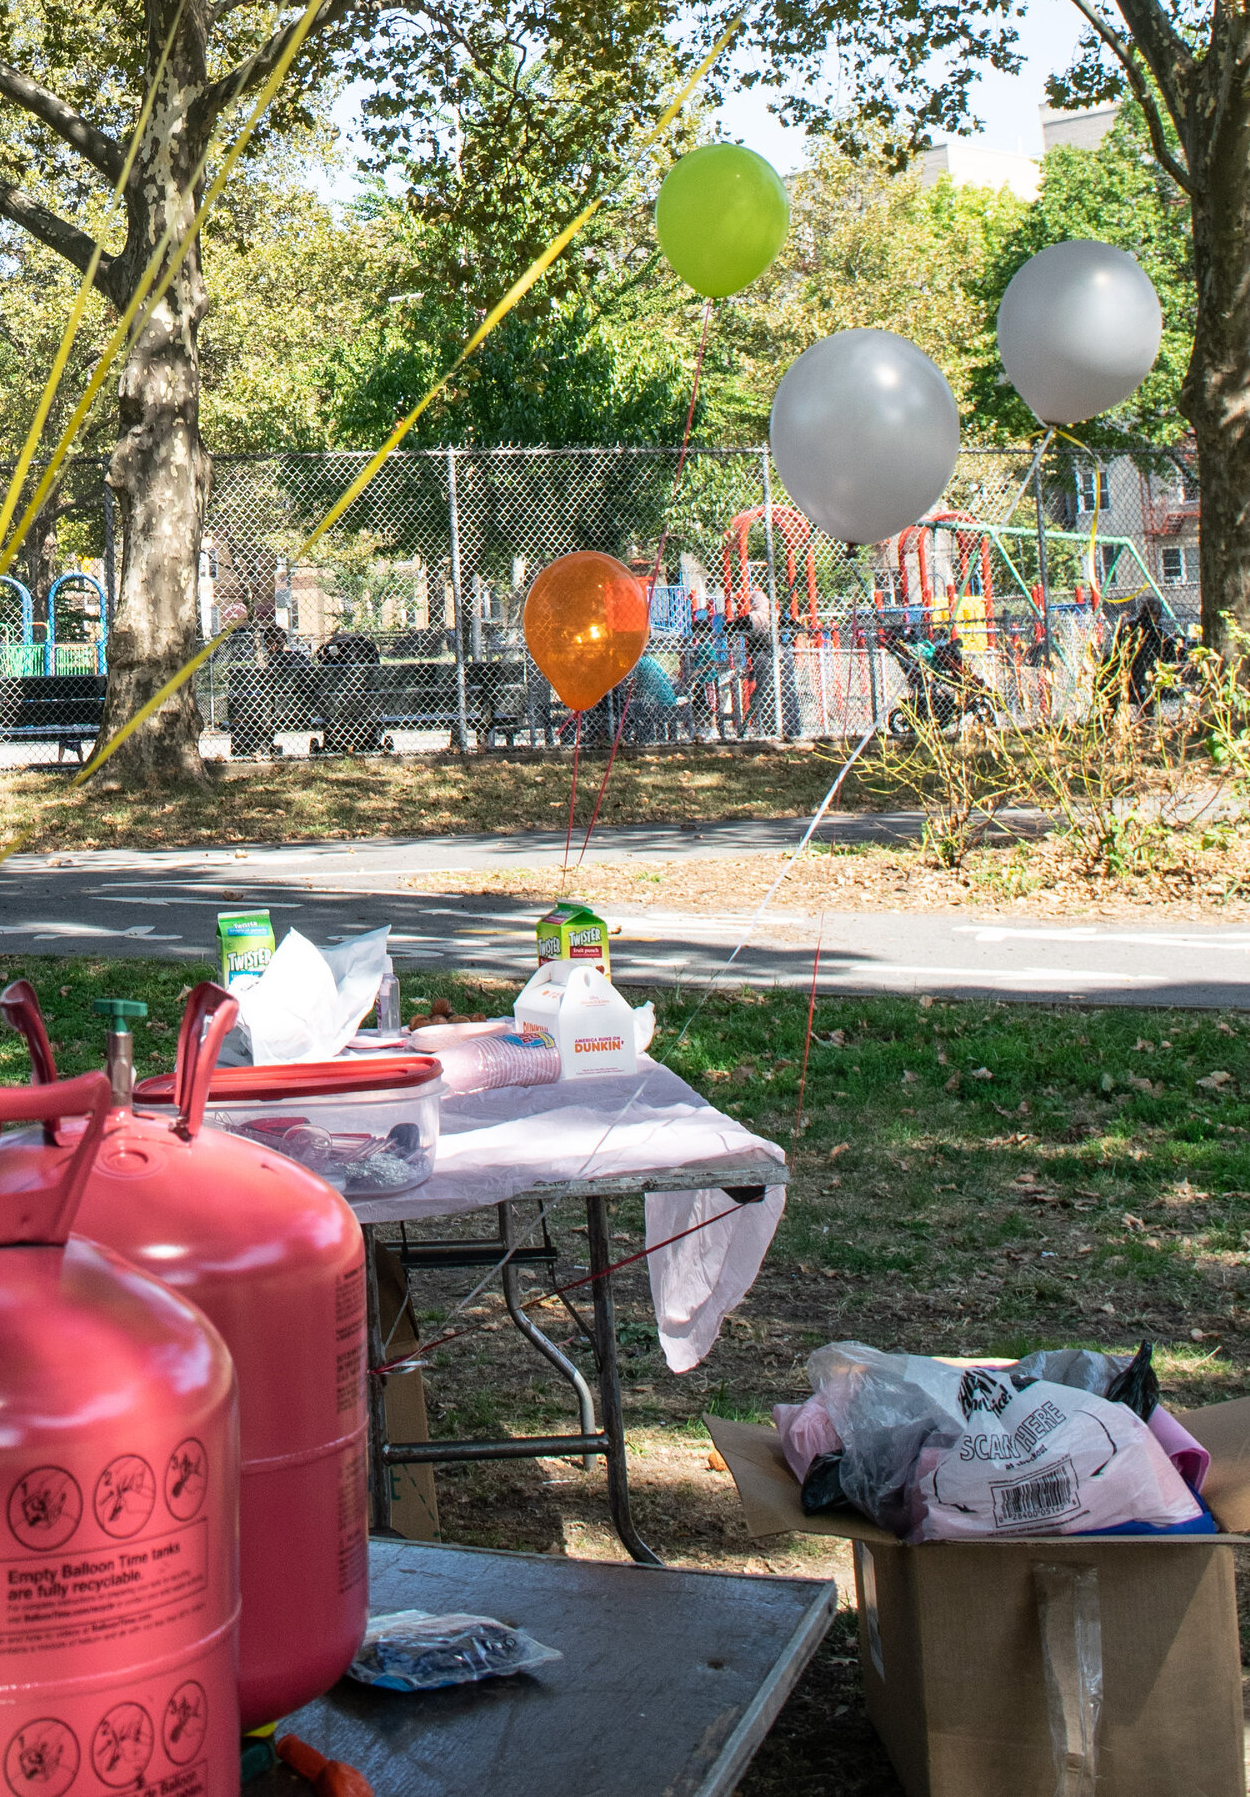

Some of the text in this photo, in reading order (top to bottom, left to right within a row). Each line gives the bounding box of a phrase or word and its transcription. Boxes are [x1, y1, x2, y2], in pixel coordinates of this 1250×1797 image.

[568, 926, 601, 947] TWISTER
[227, 947, 272, 972] TWISTER
[574, 1040, 624, 1053] DUNKIN'
[960, 1400, 1067, 1461] SCAN HERE
[7, 1542, 181, 1585] Empty Balloon Time tanks
[7, 1588, 34, 1601] are
[37, 1581, 69, 1600] fully
[72, 1569, 144, 1595] recyclable.
